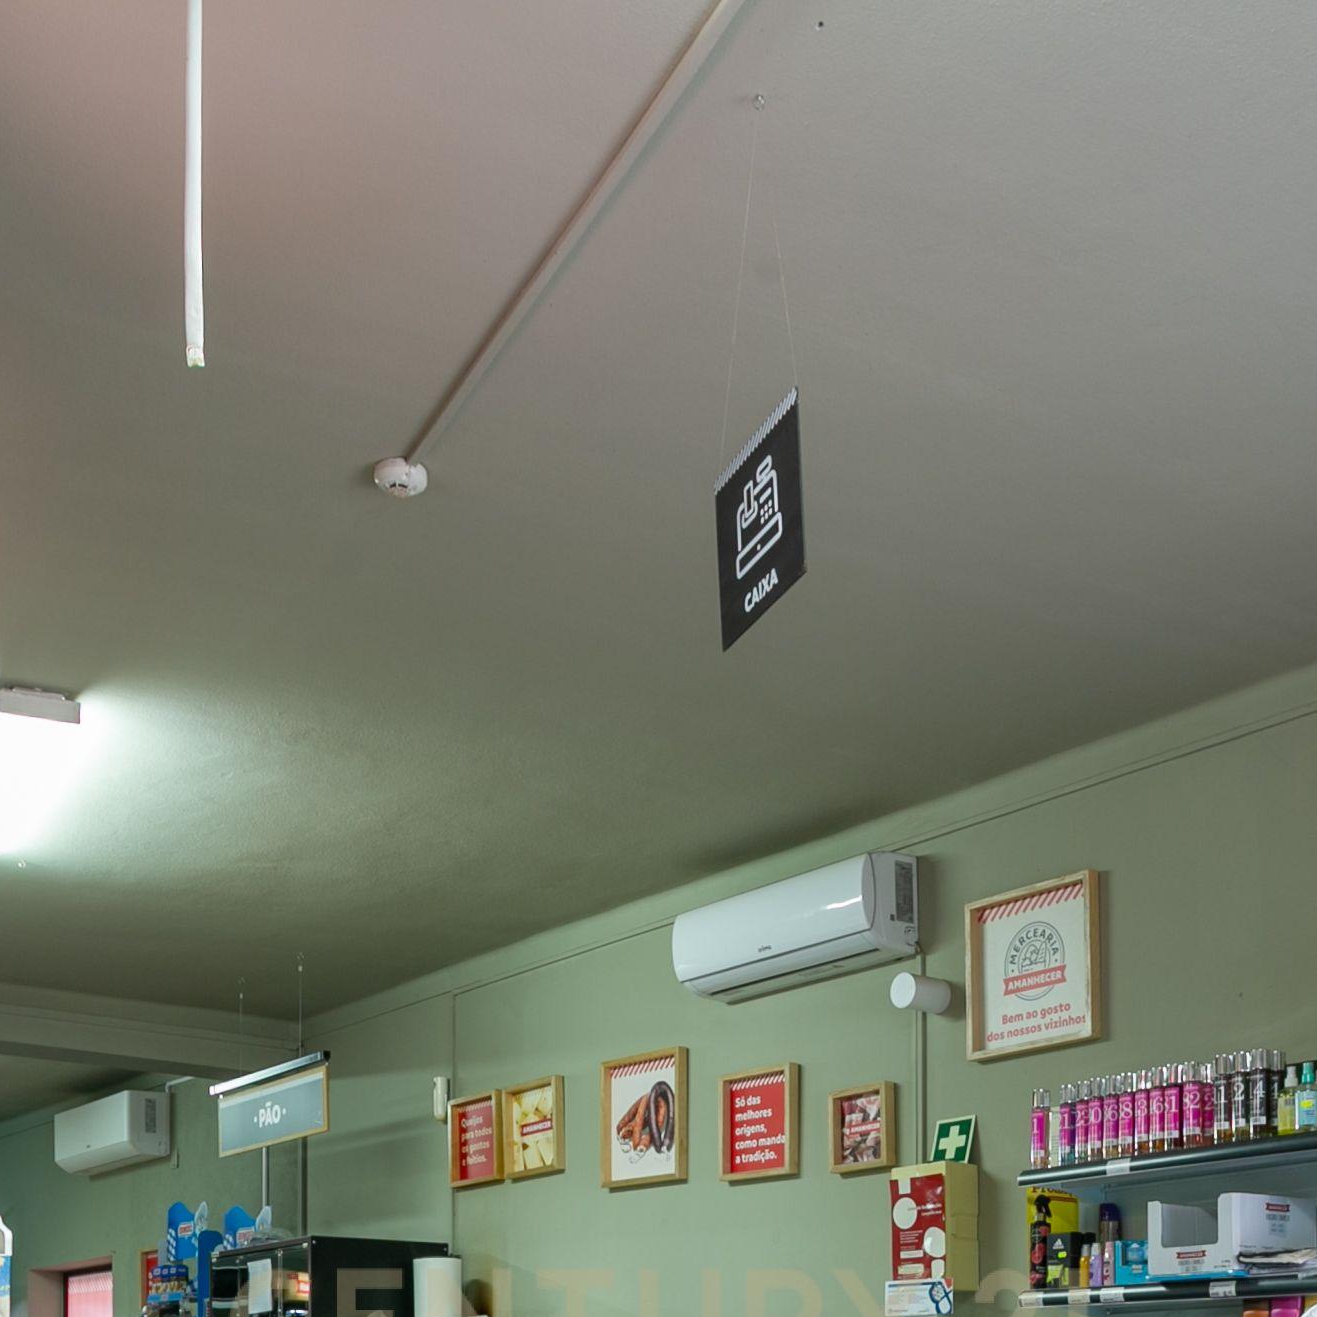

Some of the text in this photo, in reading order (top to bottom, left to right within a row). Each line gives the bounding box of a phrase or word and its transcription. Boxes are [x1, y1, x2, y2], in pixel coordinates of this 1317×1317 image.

[744, 567, 779, 613] CAIXA
[1010, 928, 1059, 965] MERCEARIA
[1007, 970, 1062, 990] AMANHECER
[1002, 1002, 1071, 1025] Bem ao gosto
[987, 1014, 1086, 1042] dos nossos vizinhos
[735, 1095, 761, 1108] Só das
[258, 1102, 281, 1127] PÃO
[735, 1108, 772, 1122] melhores
[735, 1124, 767, 1136] origens,
[735, 1140, 757, 1150] como
[735, 1150, 777, 1164] a tradição.
